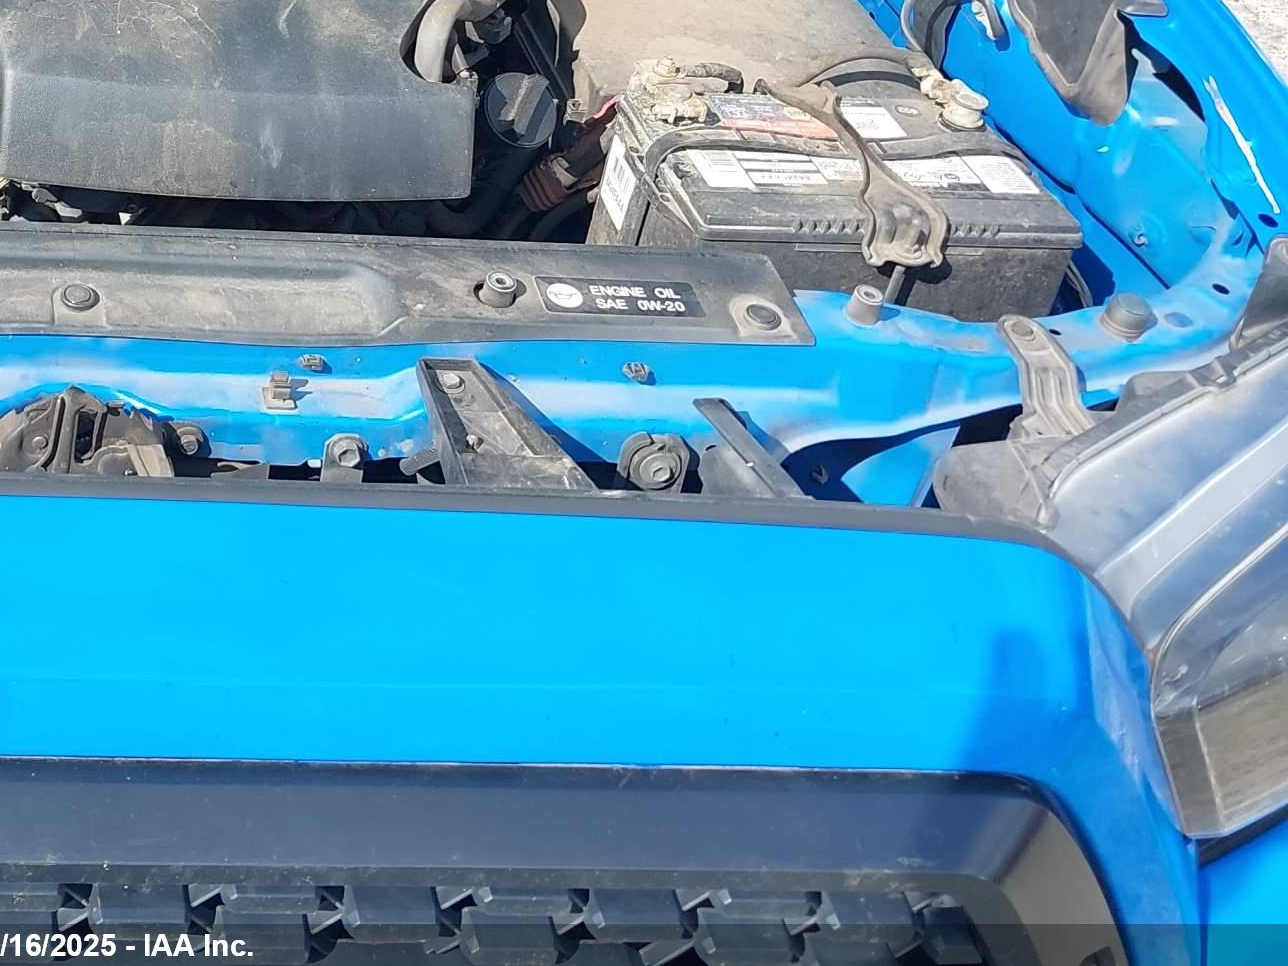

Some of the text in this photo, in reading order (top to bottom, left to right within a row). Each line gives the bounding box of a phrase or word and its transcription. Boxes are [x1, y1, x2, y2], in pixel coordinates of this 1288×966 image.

[588, 285, 681, 299] ENGINE OIL
[595, 298, 686, 312] SAE 0W-20
